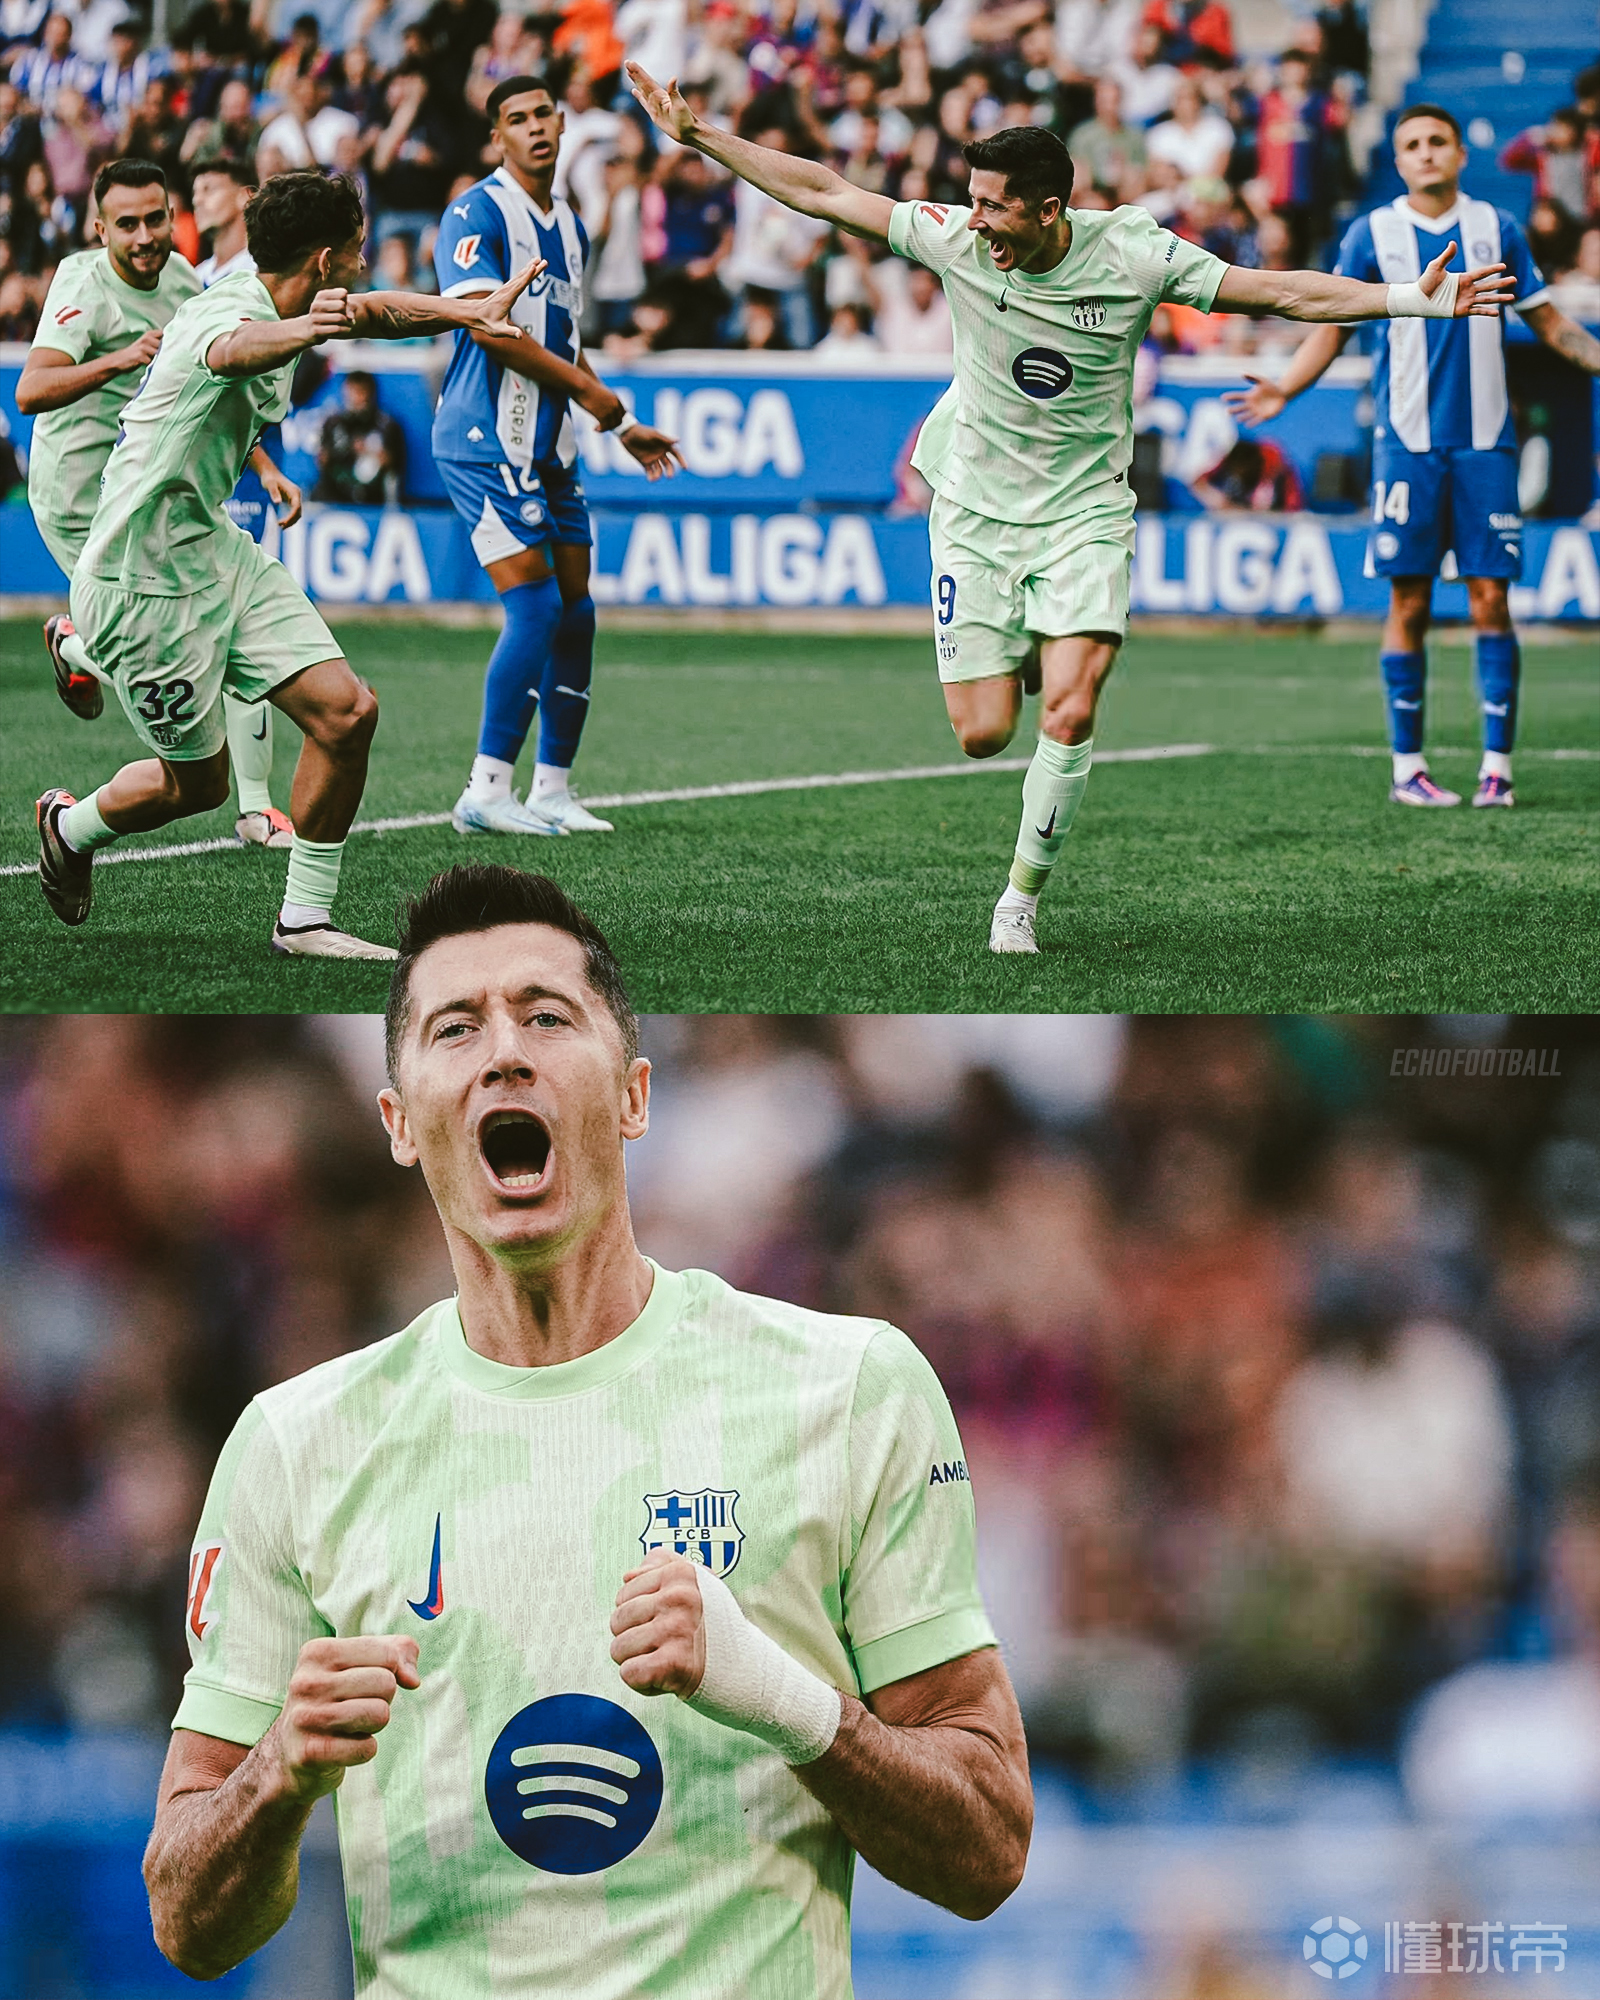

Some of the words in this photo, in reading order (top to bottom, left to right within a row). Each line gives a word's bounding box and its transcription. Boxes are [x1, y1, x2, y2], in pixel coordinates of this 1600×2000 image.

[510, 393, 527, 446] araba
[1373, 480, 1410, 525] 14
[938, 574, 957, 625] 9
[136, 678, 196, 721] 32
[674, 1529, 711, 1541] FCB
